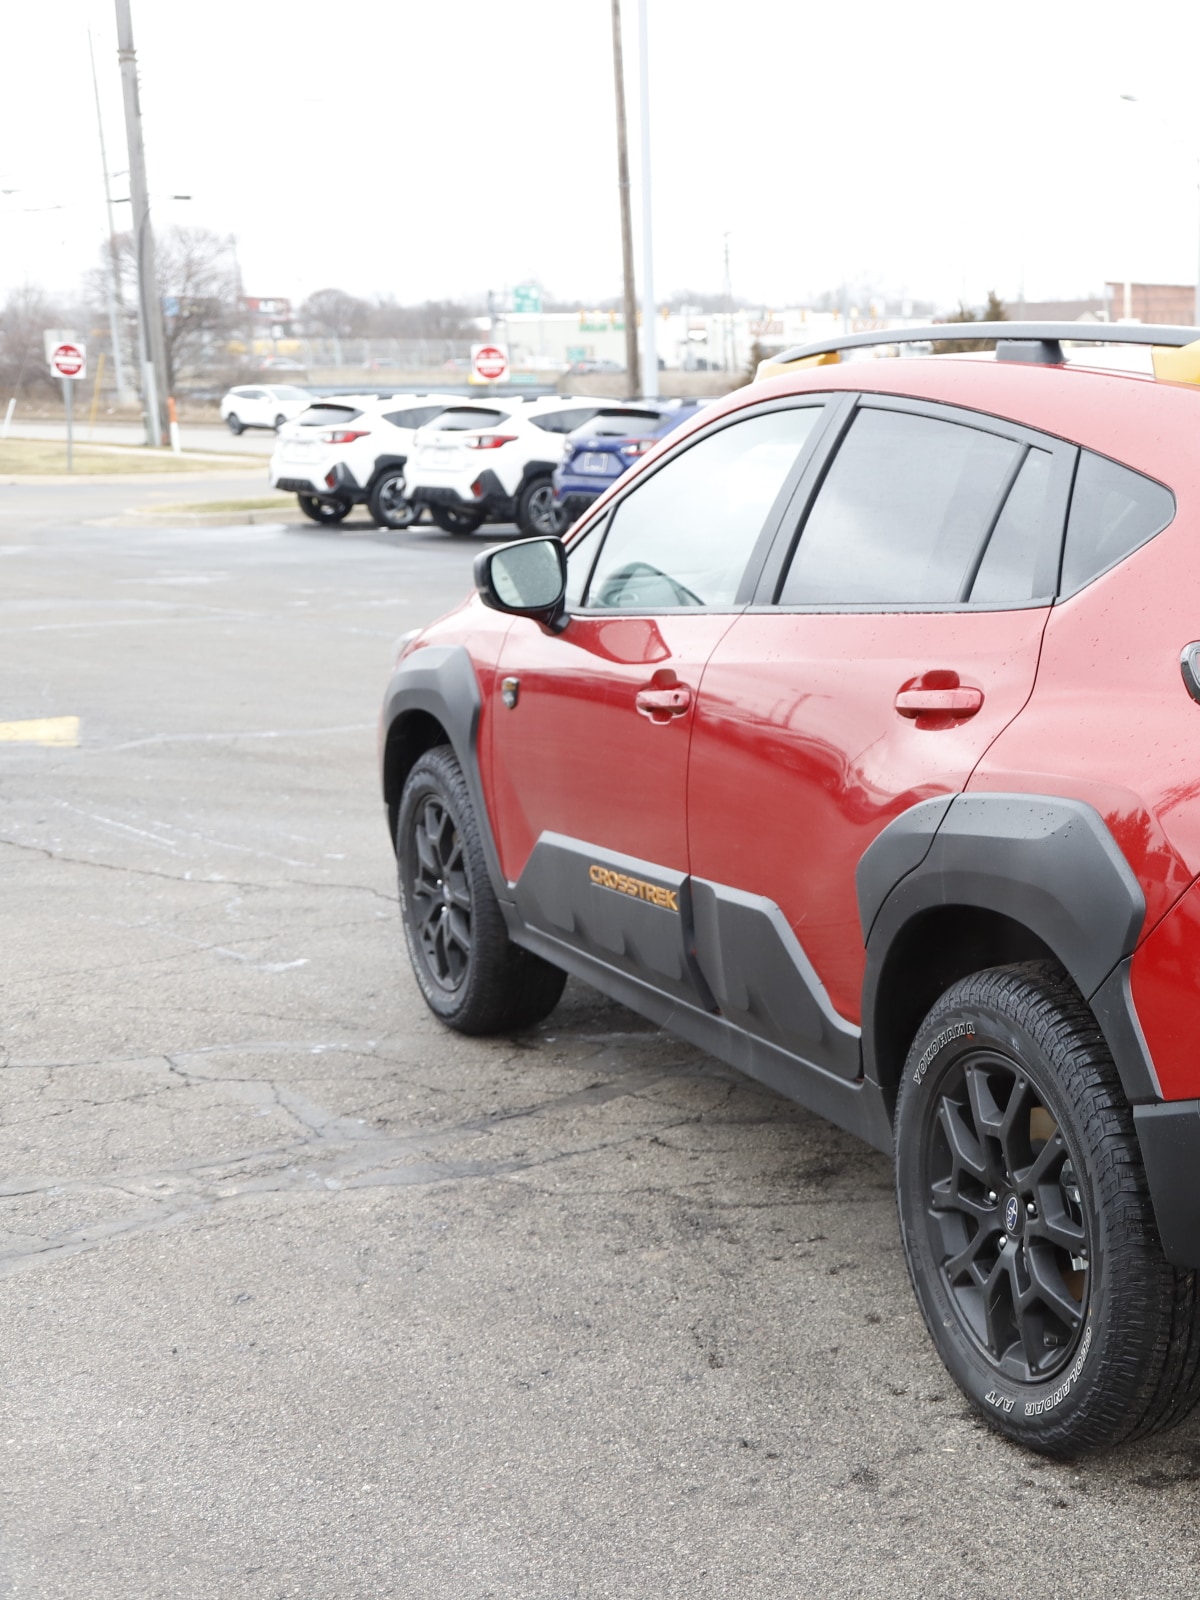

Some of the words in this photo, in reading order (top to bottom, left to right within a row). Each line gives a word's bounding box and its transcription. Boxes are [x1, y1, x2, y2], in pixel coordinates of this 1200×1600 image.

[588, 865, 679, 911] CROSSTREK
[912, 1022, 976, 1085] YOKOHAMA
[1024, 1326, 1092, 1416] GEOLANDAR
[984, 1390, 1015, 1413] A/T
